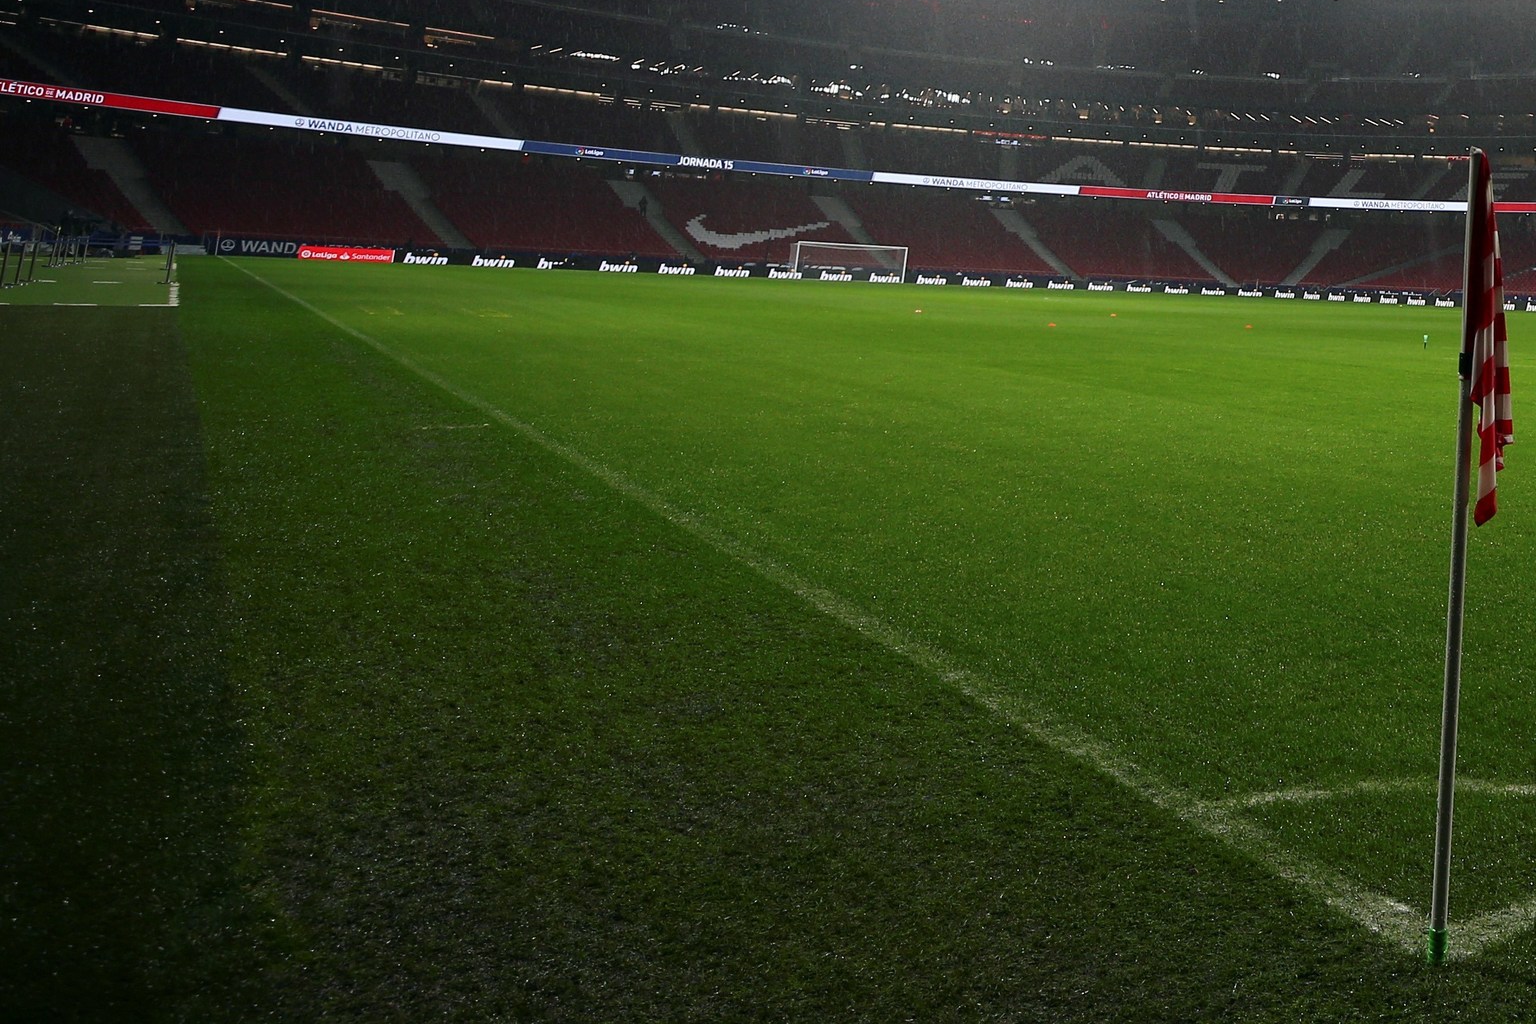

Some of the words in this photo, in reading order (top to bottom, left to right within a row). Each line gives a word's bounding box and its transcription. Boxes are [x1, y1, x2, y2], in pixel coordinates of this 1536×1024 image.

[0, 82, 44, 96] LÉTICO
[56, 89, 106, 104] MADRID
[308, 119, 353, 132] WANDA
[355, 125, 441, 142] METROPOLITANO
[585, 148, 604, 156] LaLiga
[677, 156, 723, 169] JORNADA
[723, 160, 733, 170] 15
[932, 178, 964, 187] WANDA
[965, 179, 1028, 191] METROPOLITANO
[1146, 190, 1178, 200] ATLÉTICO
[1184, 193, 1212, 201] MADRID
[1391, 202, 1445, 210] METROPOLITANO
[351, 253, 391, 261] Santander
[403, 252, 448, 266] bwin
[472, 255, 515, 268] bwin
[599, 261, 638, 273] bwin
[658, 263, 695, 275] bwin
[714, 266, 750, 278] bwin
[820, 270, 853, 282] bwin
[869, 272, 901, 283] bwin
[916, 274, 947, 285] bwin
[962, 276, 991, 287] bwin
